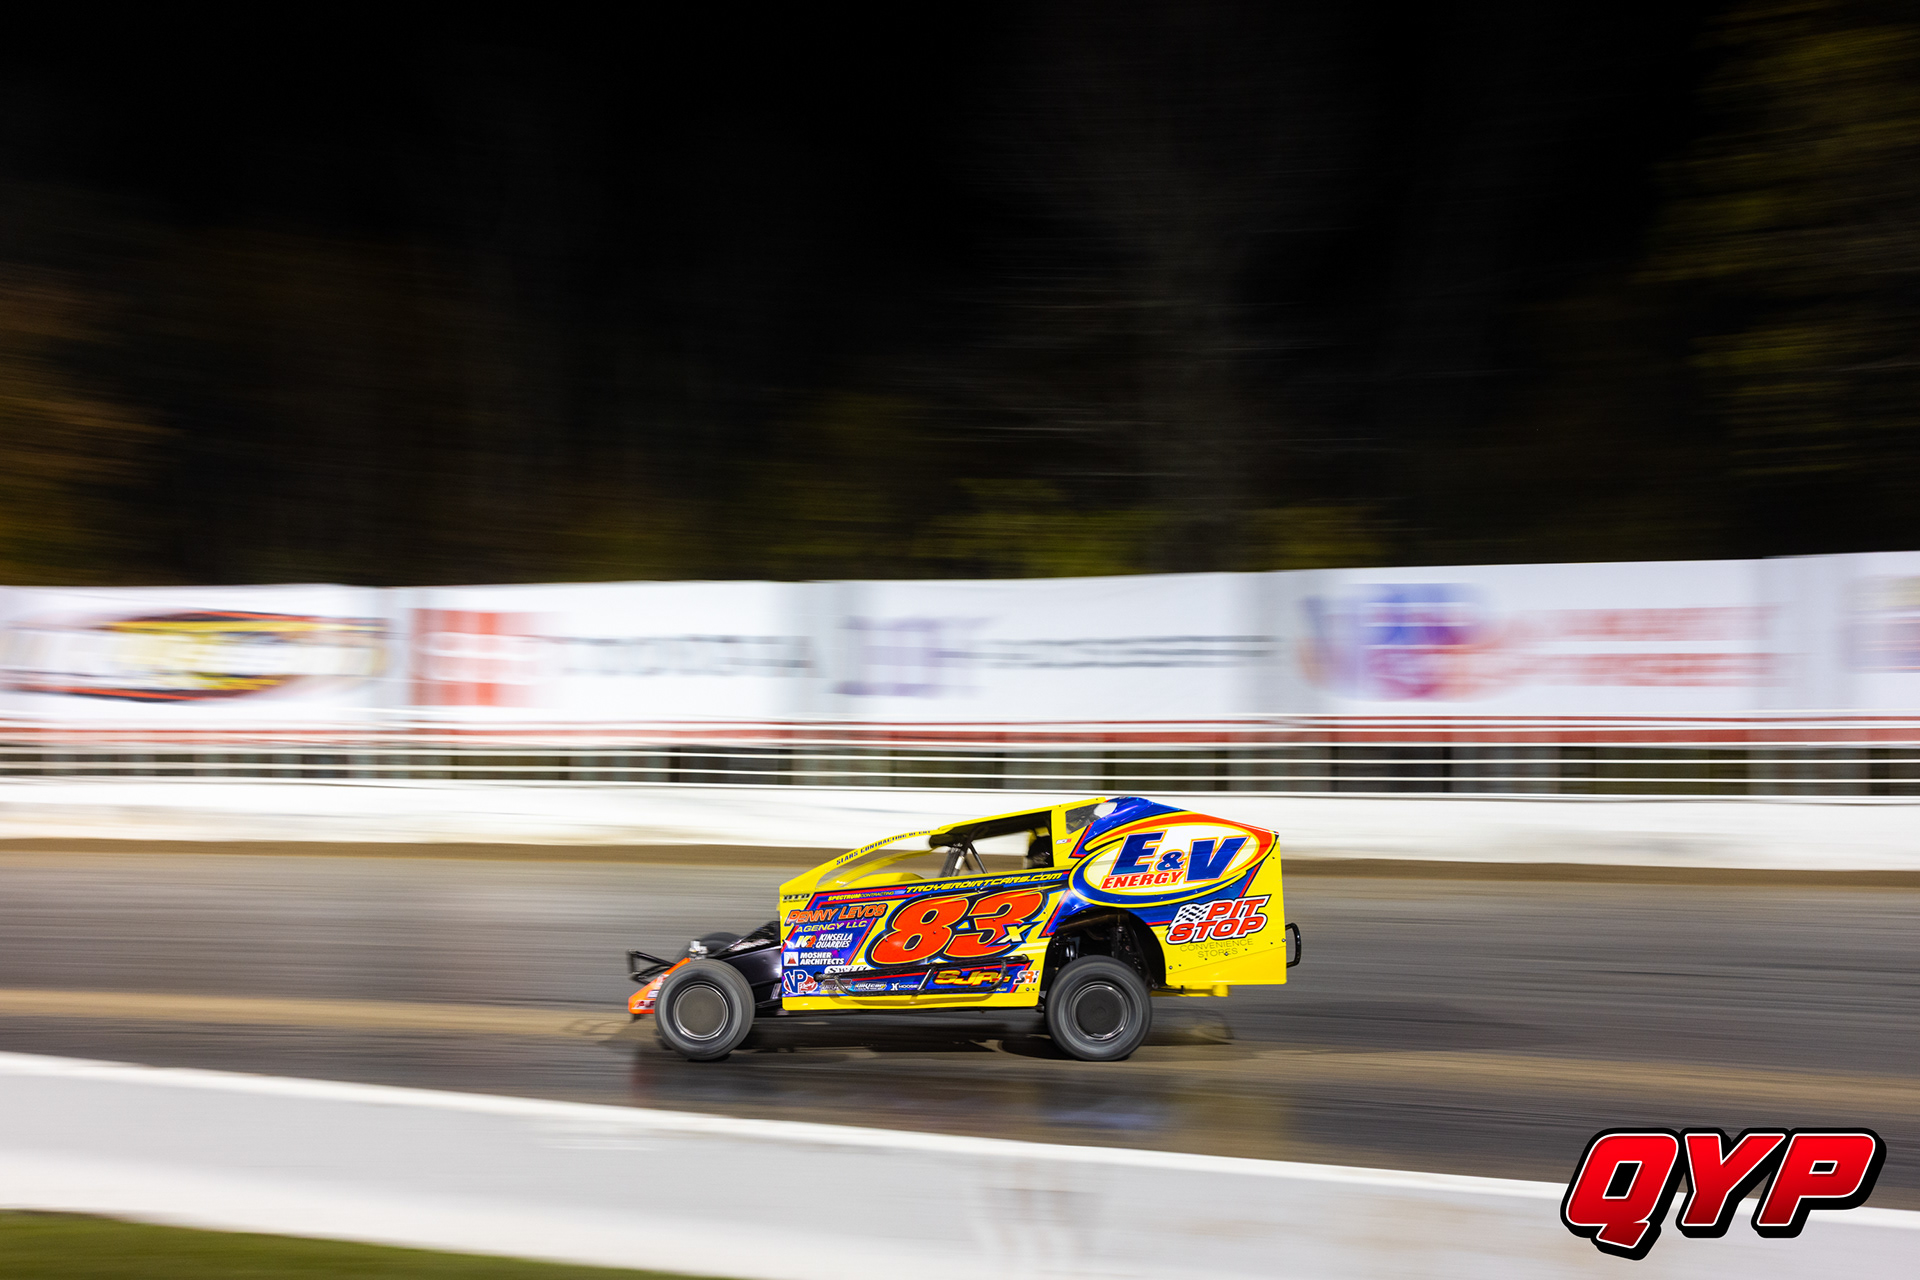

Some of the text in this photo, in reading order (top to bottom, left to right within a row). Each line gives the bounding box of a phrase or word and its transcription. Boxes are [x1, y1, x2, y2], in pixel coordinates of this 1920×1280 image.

[1110, 831, 1250, 882] E&V
[906, 873, 1063, 894] TROYERDIRTCARS.COM
[1100, 871, 1185, 890] ENERGY
[785, 903, 888, 925] PENNY LEVOS
[1206, 898, 1267, 920] PIT
[794, 920, 868, 934] AGENCY LLC
[1169, 916, 1265, 942] STOP
[815, 940, 851, 949] QUARRIES
[819, 933, 853, 941] KINSELLA
[1179, 938, 1254, 953] CONVENIENCE
[799, 958, 845, 966] ARCHITECTS
[1197, 947, 1239, 959] STORES
[785, 970, 808, 994] VP
